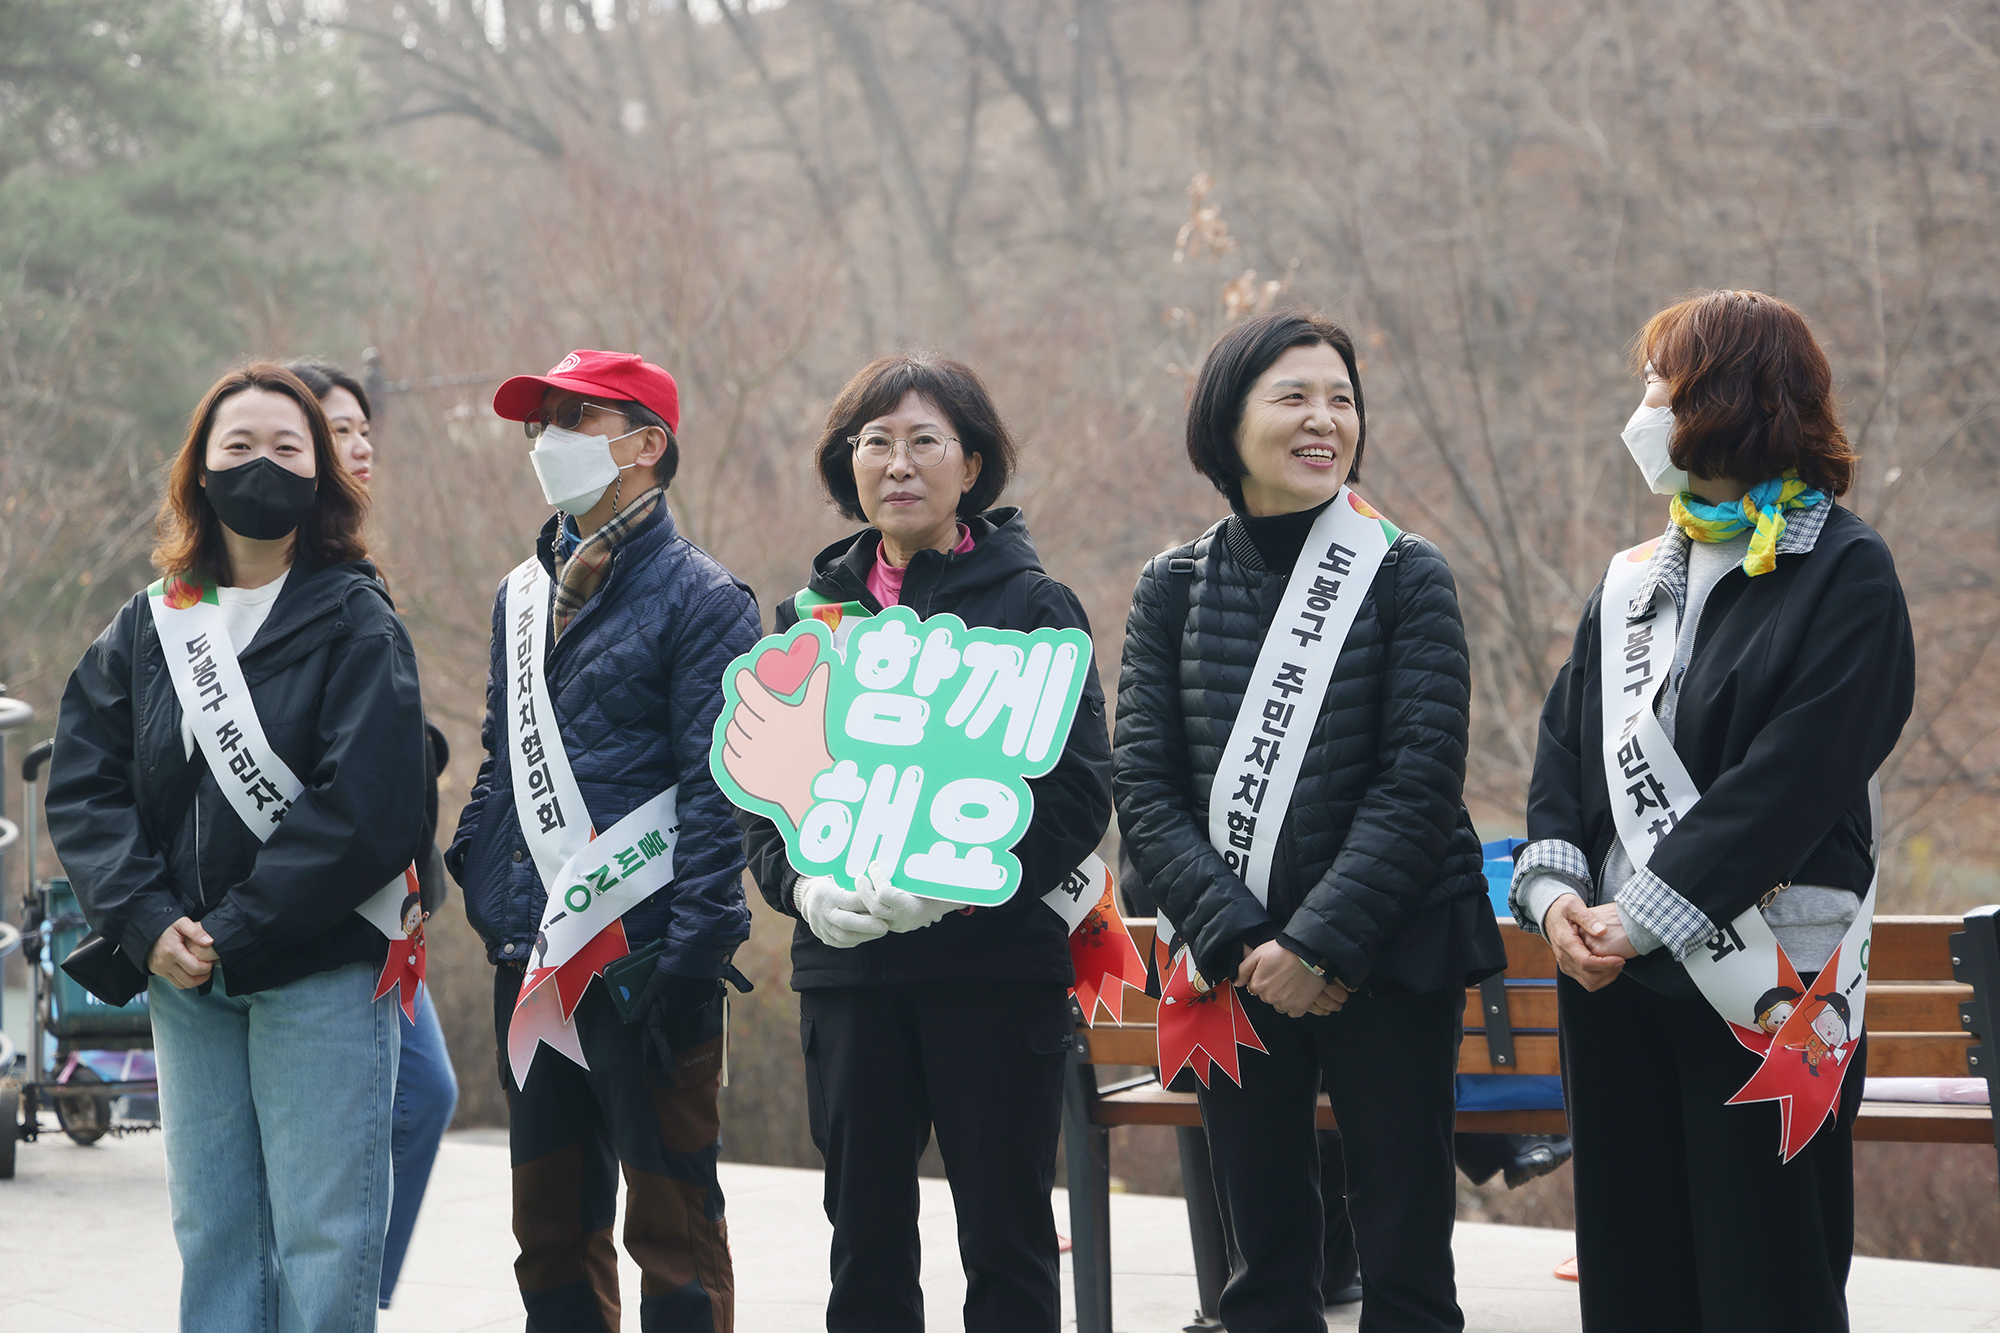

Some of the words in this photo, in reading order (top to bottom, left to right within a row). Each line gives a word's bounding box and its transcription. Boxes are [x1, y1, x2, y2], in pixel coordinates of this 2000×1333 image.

[1291, 542, 1357, 647] 도봉구
[185, 632, 228, 712] 도봉구
[517, 604, 566, 835] 주민자치협의회
[845, 620, 1078, 762] 함께
[800, 760, 1019, 890] 해요
